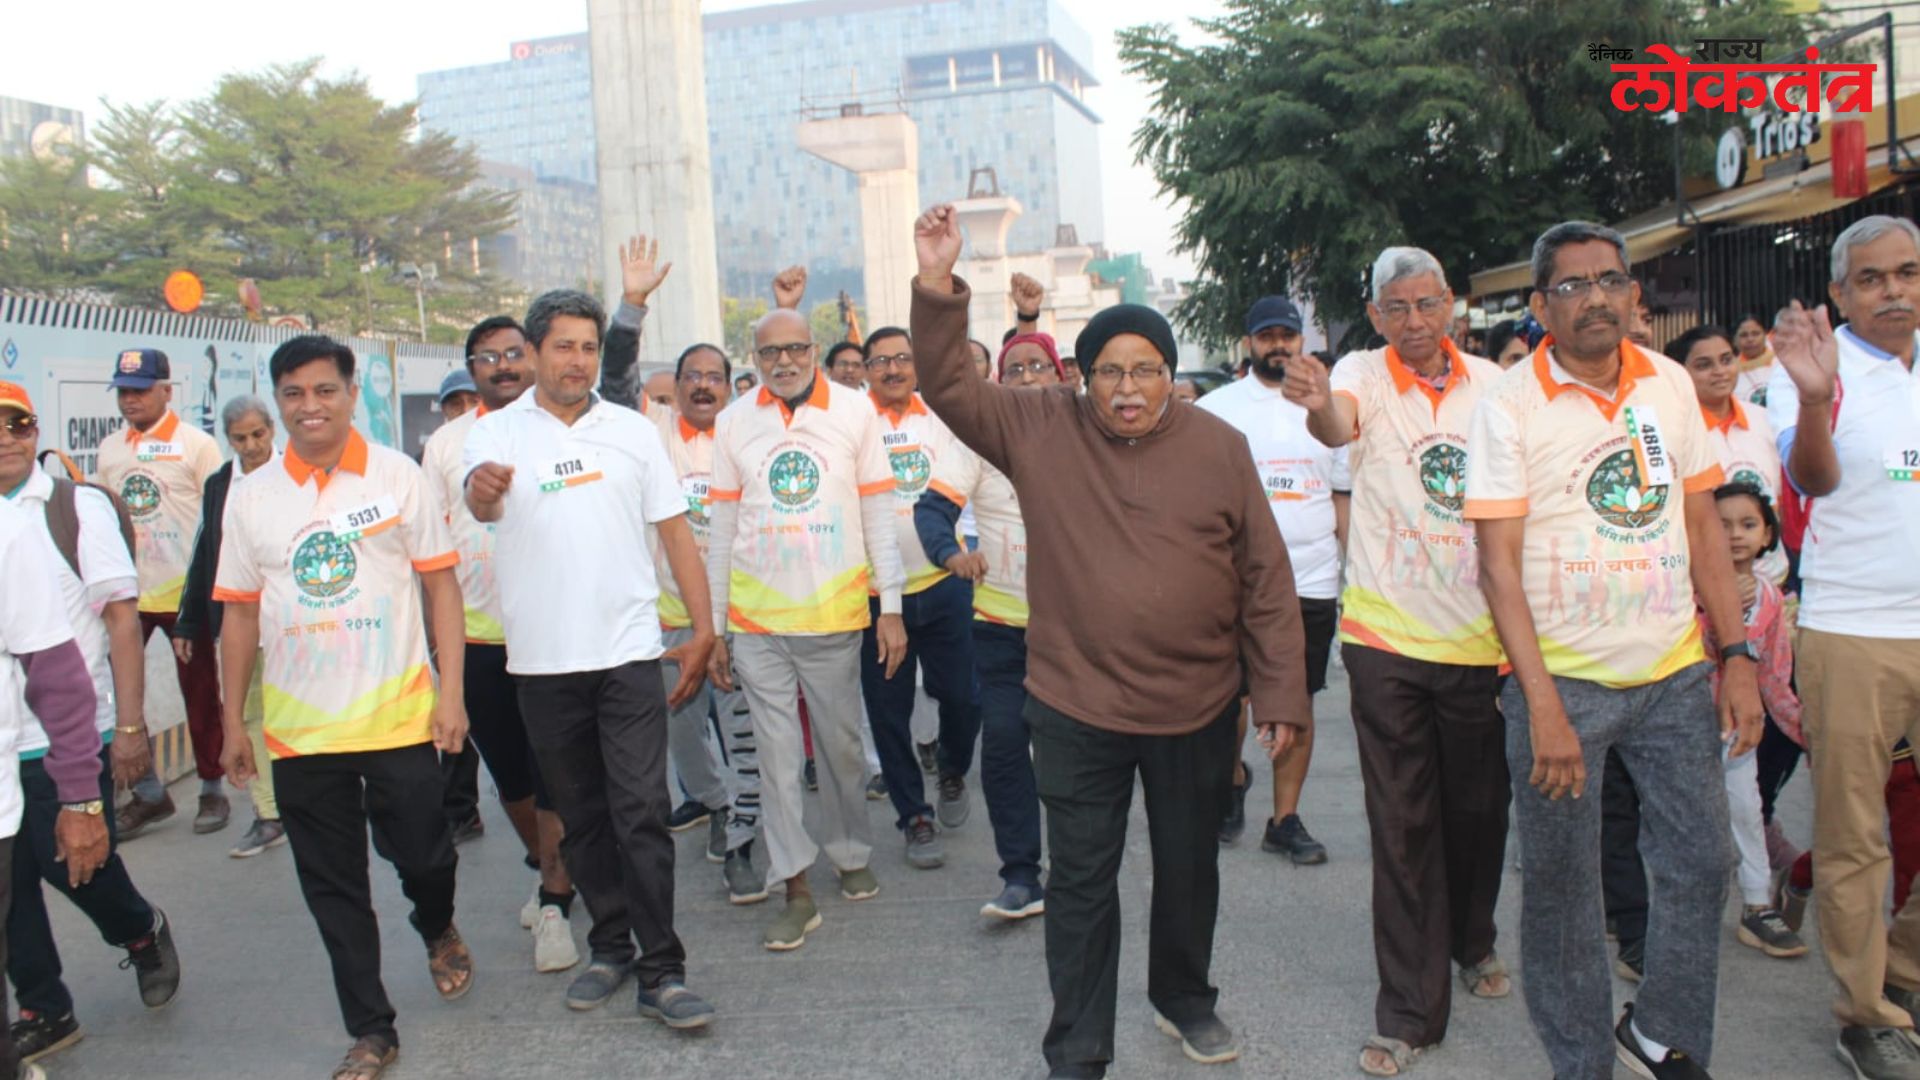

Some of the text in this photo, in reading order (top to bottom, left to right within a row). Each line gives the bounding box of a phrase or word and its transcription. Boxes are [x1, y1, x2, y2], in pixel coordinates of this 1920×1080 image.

[1750, 112, 1816, 161] Trios
[1640, 423, 1665, 468] 4886
[554, 458, 584, 477] 4174
[347, 505, 382, 528] 5131
[1563, 555, 1597, 575] नमो
[1604, 557, 1652, 573] चषक
